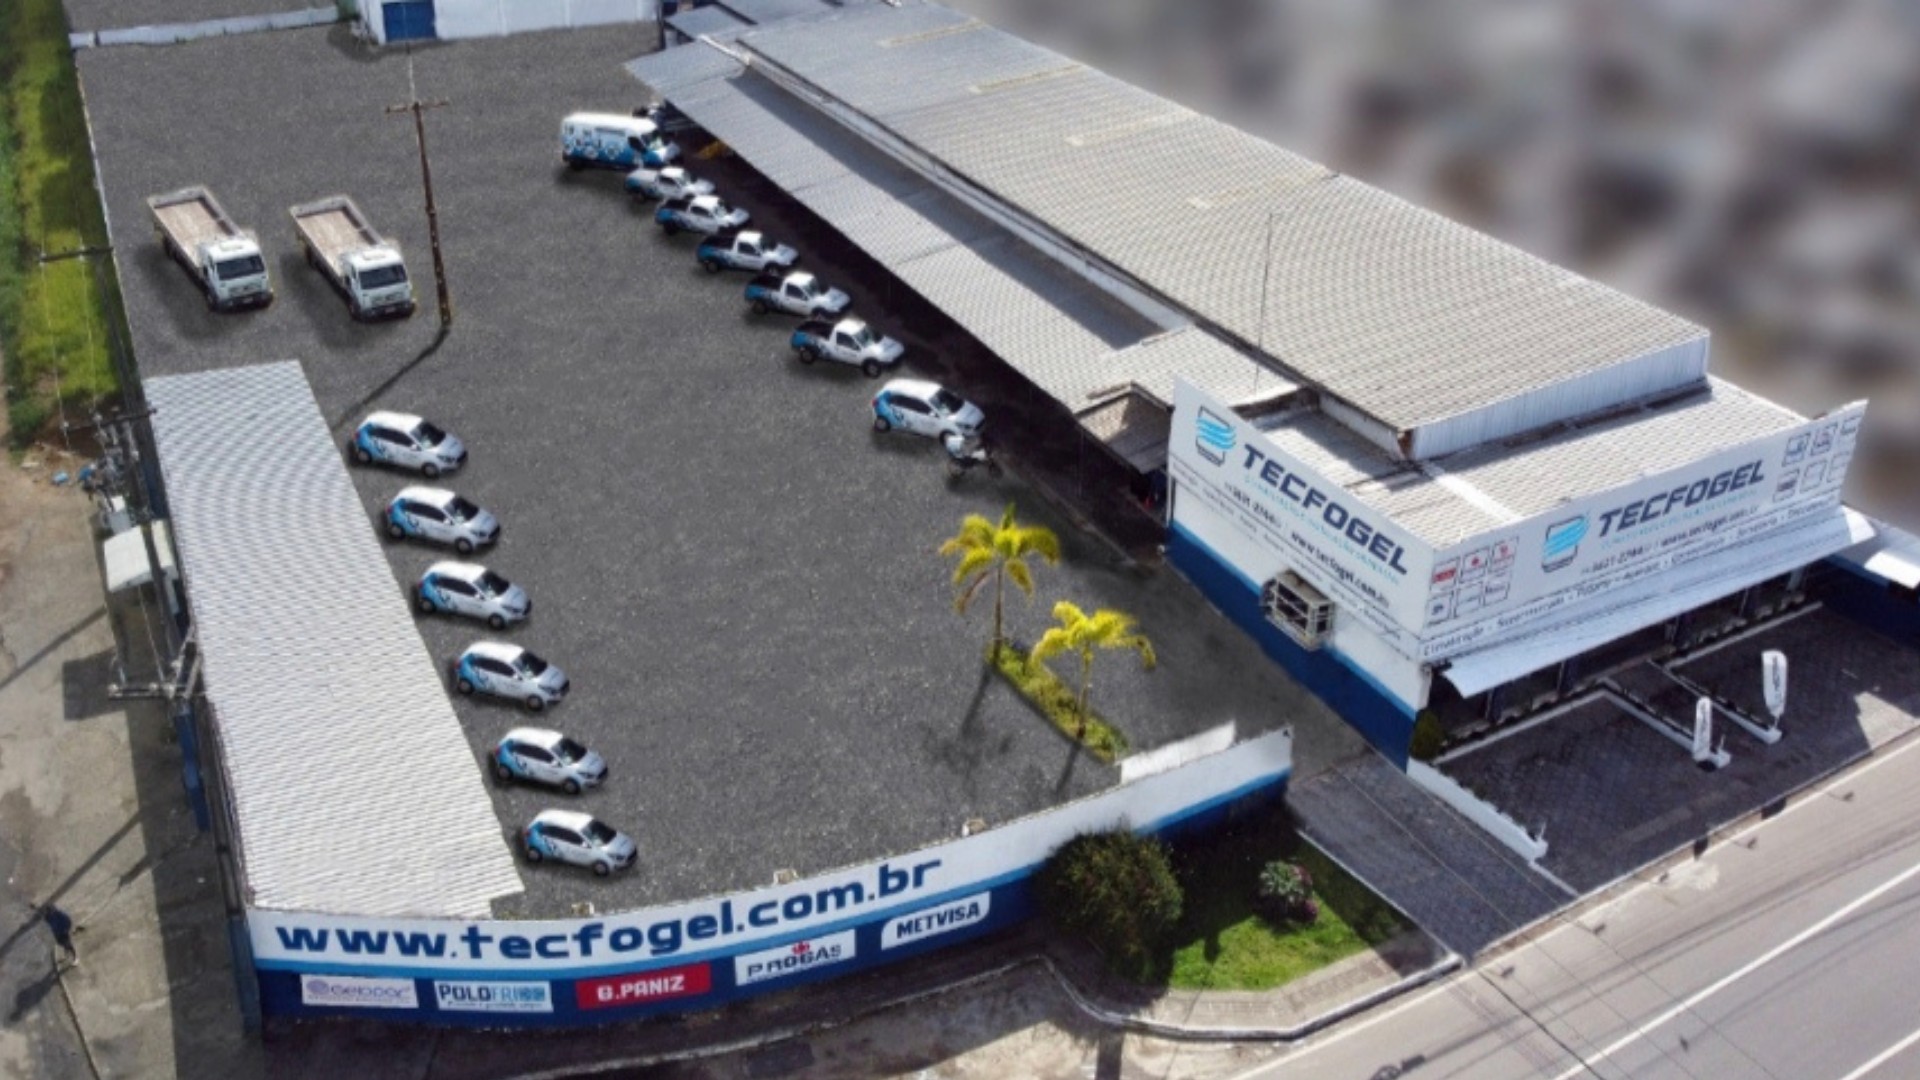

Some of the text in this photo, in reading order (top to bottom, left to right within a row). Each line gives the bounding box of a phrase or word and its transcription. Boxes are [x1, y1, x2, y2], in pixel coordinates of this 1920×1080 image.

[1243, 443, 1408, 576] TECFOGEL
[1599, 459, 1765, 538] TECFOGEL
[275, 859, 942, 961] www.tecfogel.com.br
[896, 902, 980, 940] METVISA
